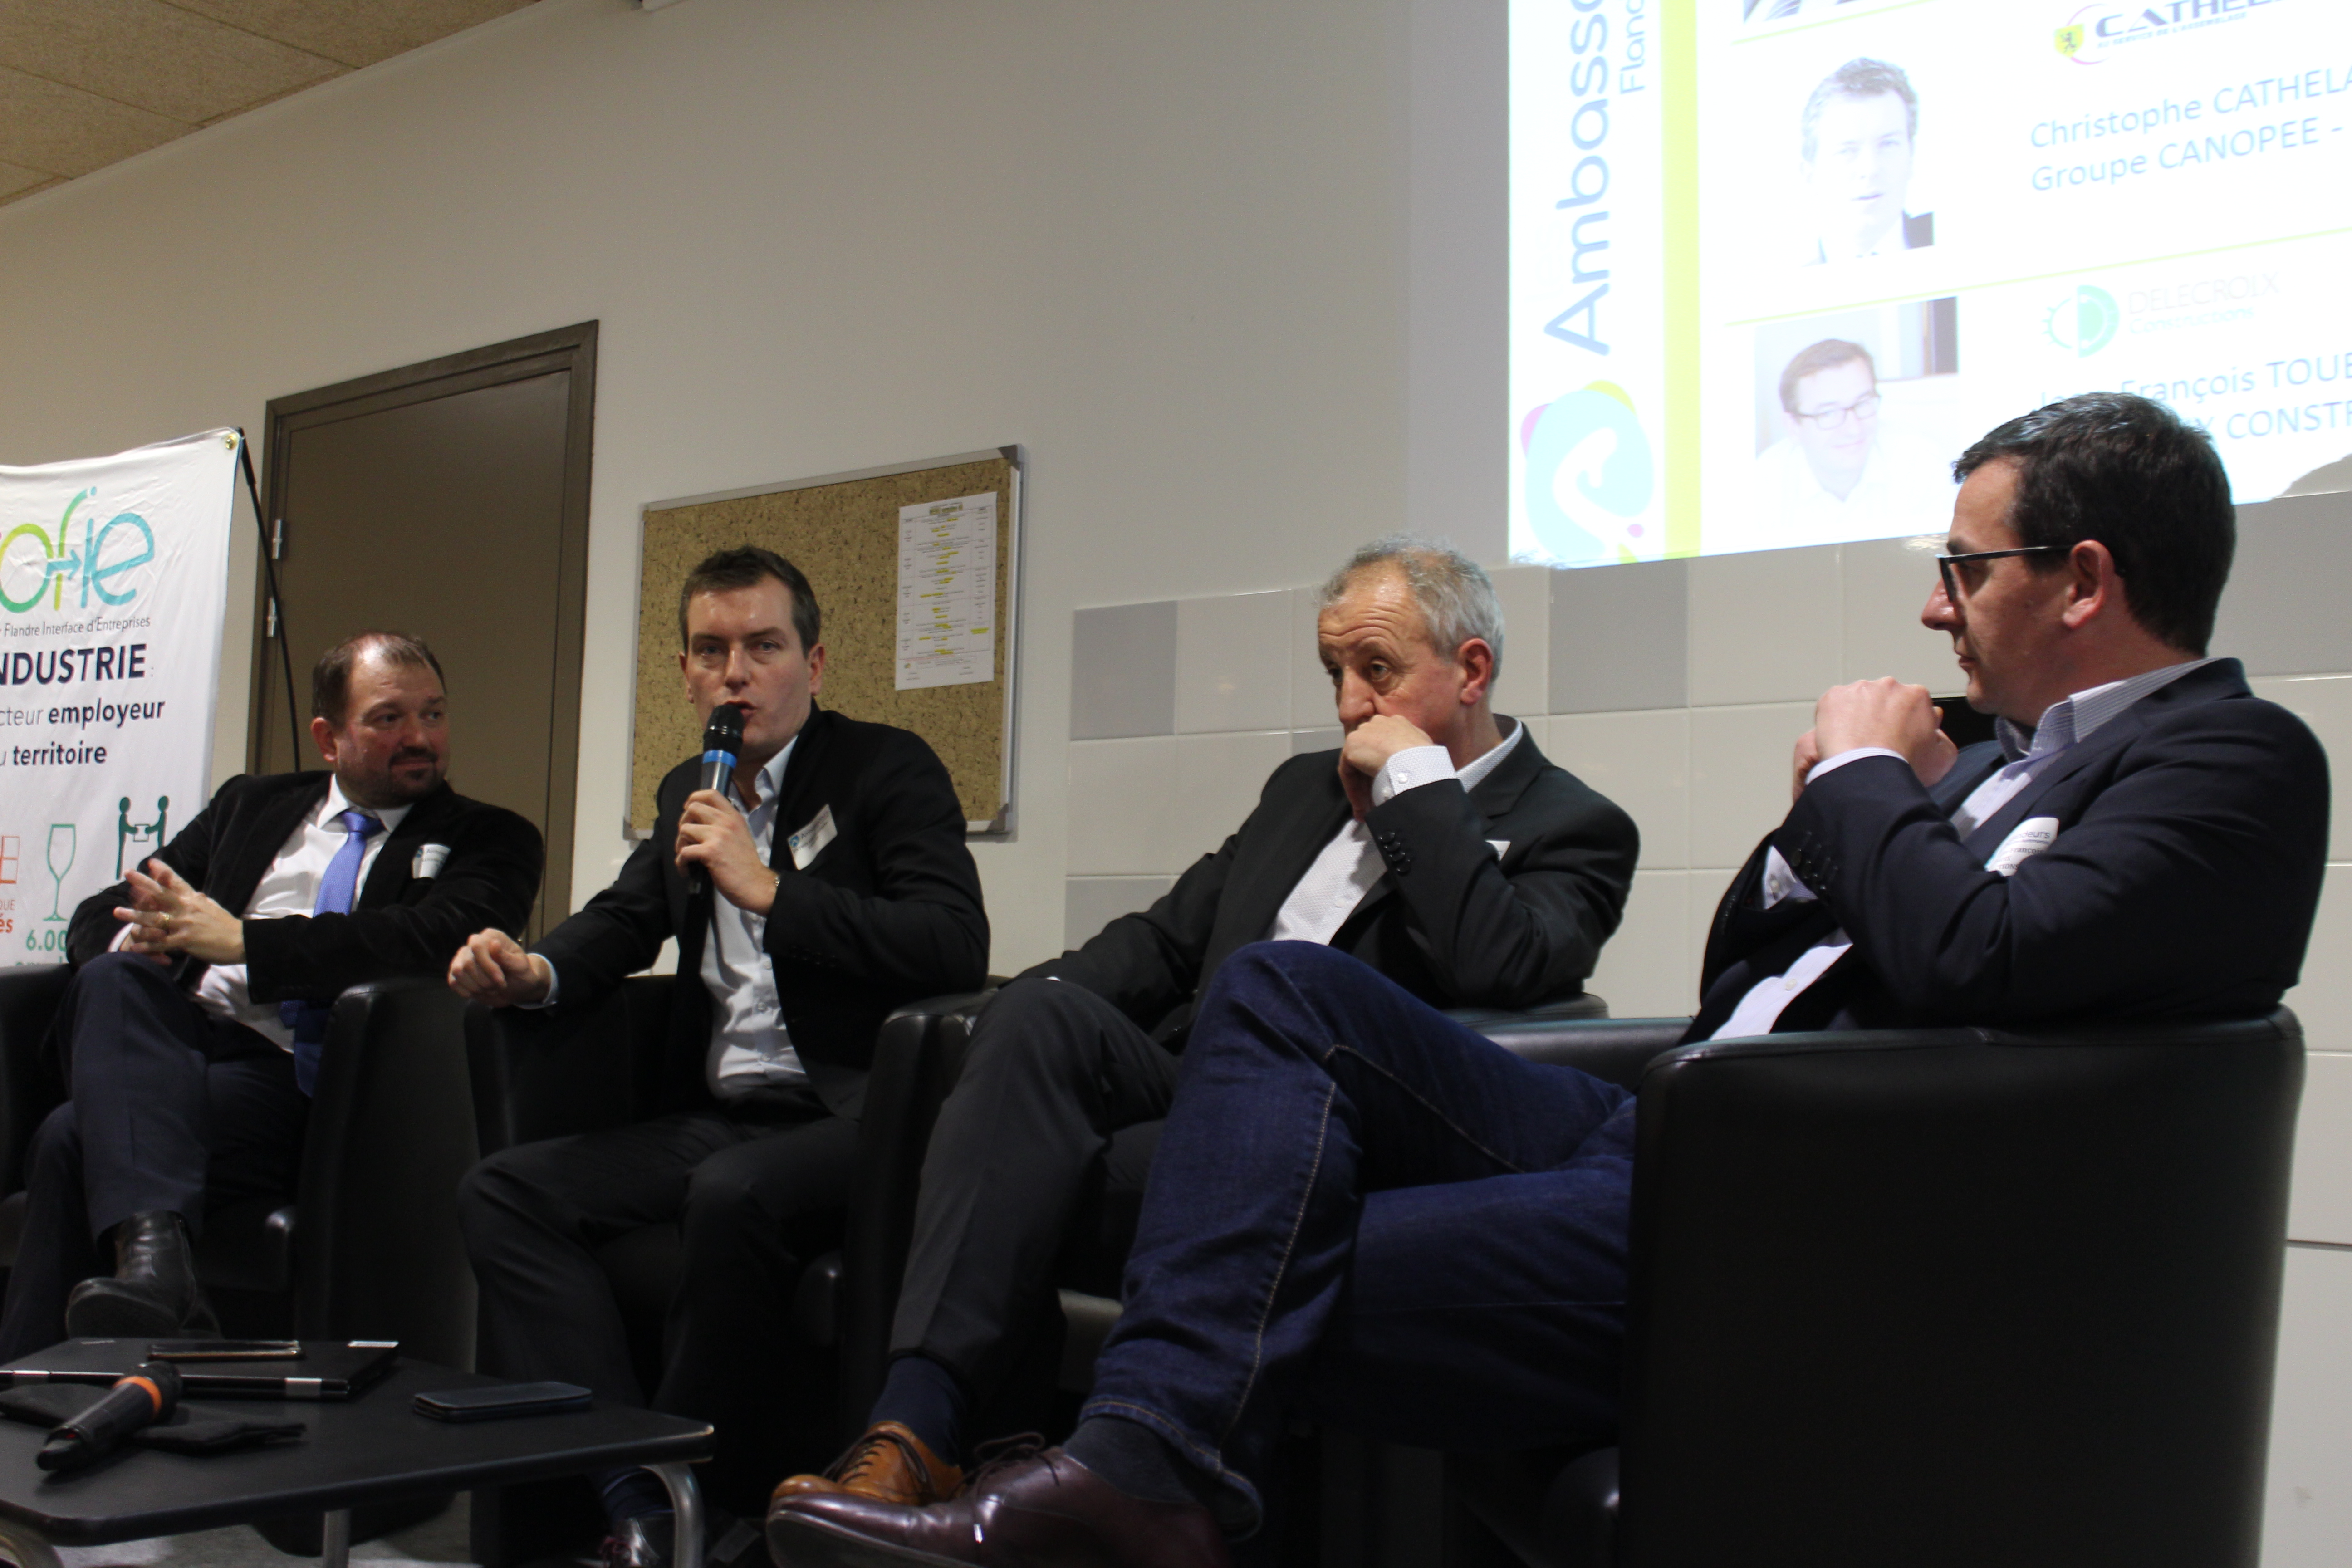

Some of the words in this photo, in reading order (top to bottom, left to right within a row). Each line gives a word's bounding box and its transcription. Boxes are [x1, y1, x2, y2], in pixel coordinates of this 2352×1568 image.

[2095, 0, 2289, 38] CATHE
[2030, 98, 2203, 148] Christophe
[2031, 154, 2148, 191] Groupe
[2158, 116, 2320, 169] CANOPEE
[2129, 271, 2281, 314] DELECROIX
[2129, 307, 2255, 334] Constructions
[0, 487, 154, 613] ofie
[5, 623, 40, 637] Flandre
[43, 622, 84, 635] Interface
[87, 617, 151, 633] d'Entreprises
[49, 697, 166, 730] employeur
[14, 740, 108, 766] territoire
[0, 900, 15, 910] UE
